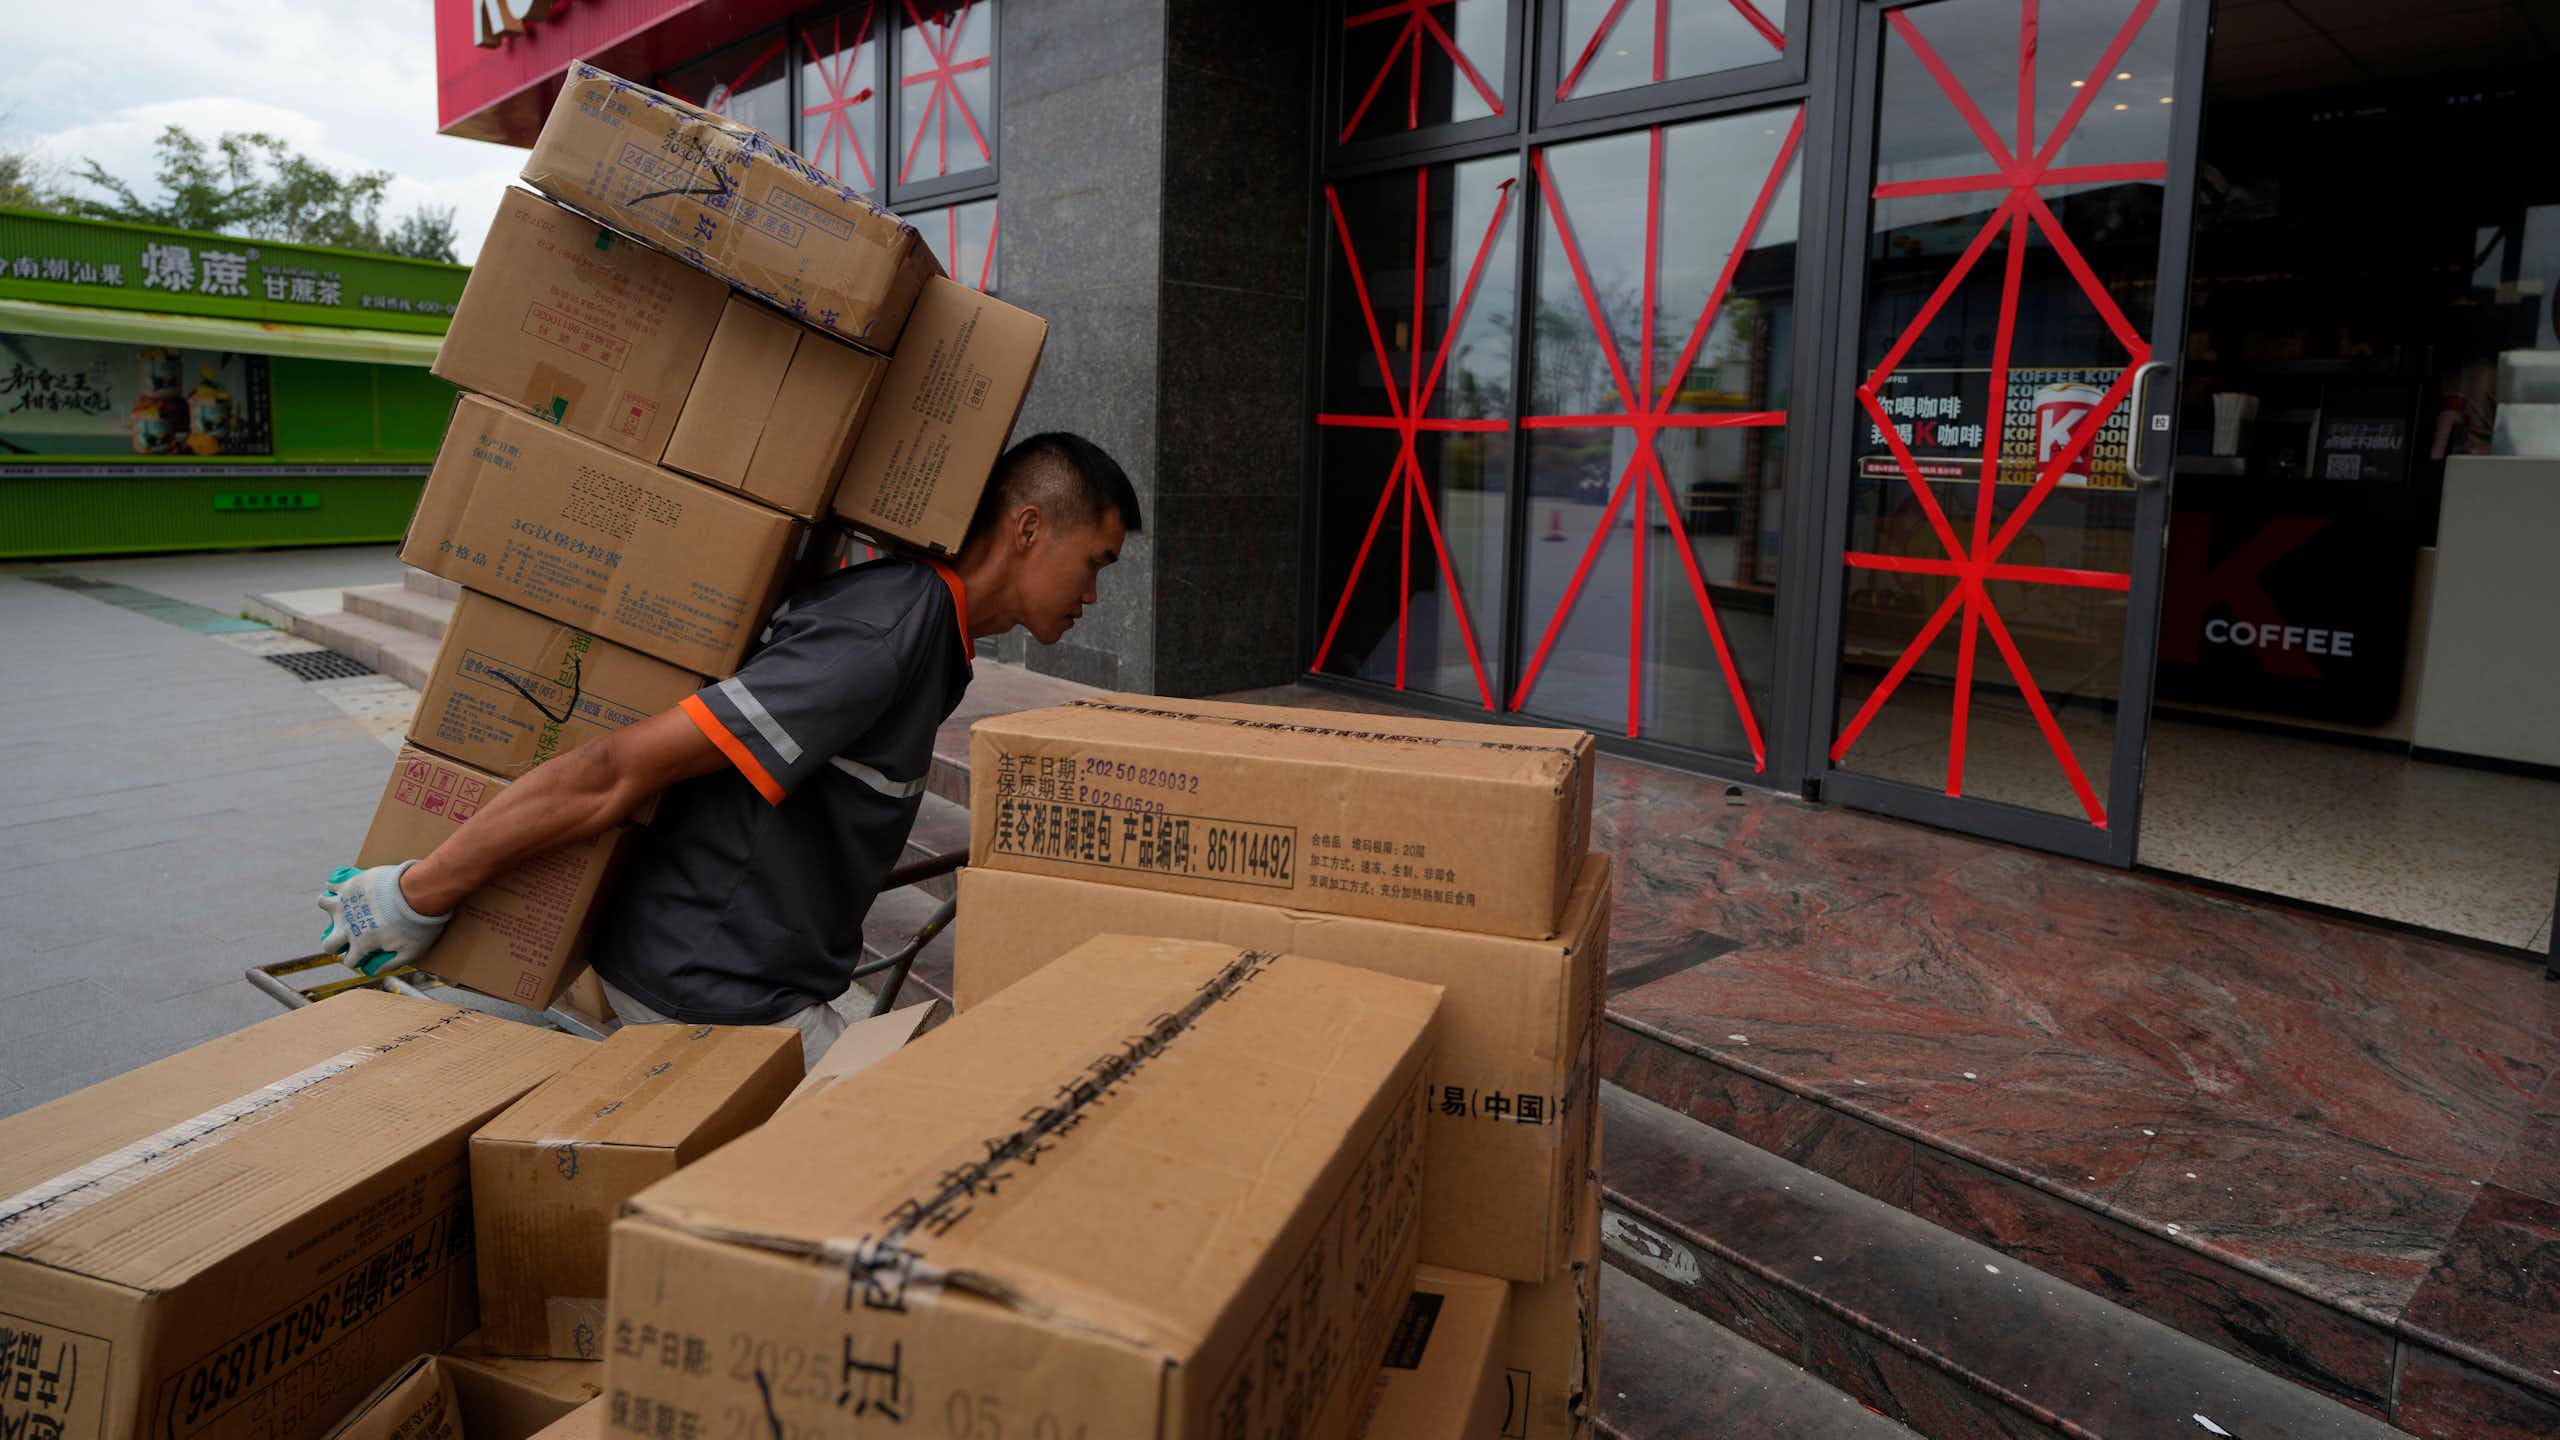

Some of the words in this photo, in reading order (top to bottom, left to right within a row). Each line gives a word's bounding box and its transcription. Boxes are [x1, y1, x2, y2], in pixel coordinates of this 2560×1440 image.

[142, 243, 250, 297] 爆蔗
[263, 275, 342, 305] 甘蔗茶
[2008, 370, 2081, 383] KOFFEE
[438, 538, 489, 568] 合格品
[510, 517, 624, 569] 3G汉堡沙拉酱
[2205, 619, 2355, 657] COFFEE
[1085, 757, 1200, 795] 20250829032
[1120, 813, 1198, 874] 产品编码：
[1207, 827, 1292, 881] 86114492
[1311, 832, 1342, 850] 合格品
[1427, 1084, 1571, 1127] 易(中国)
